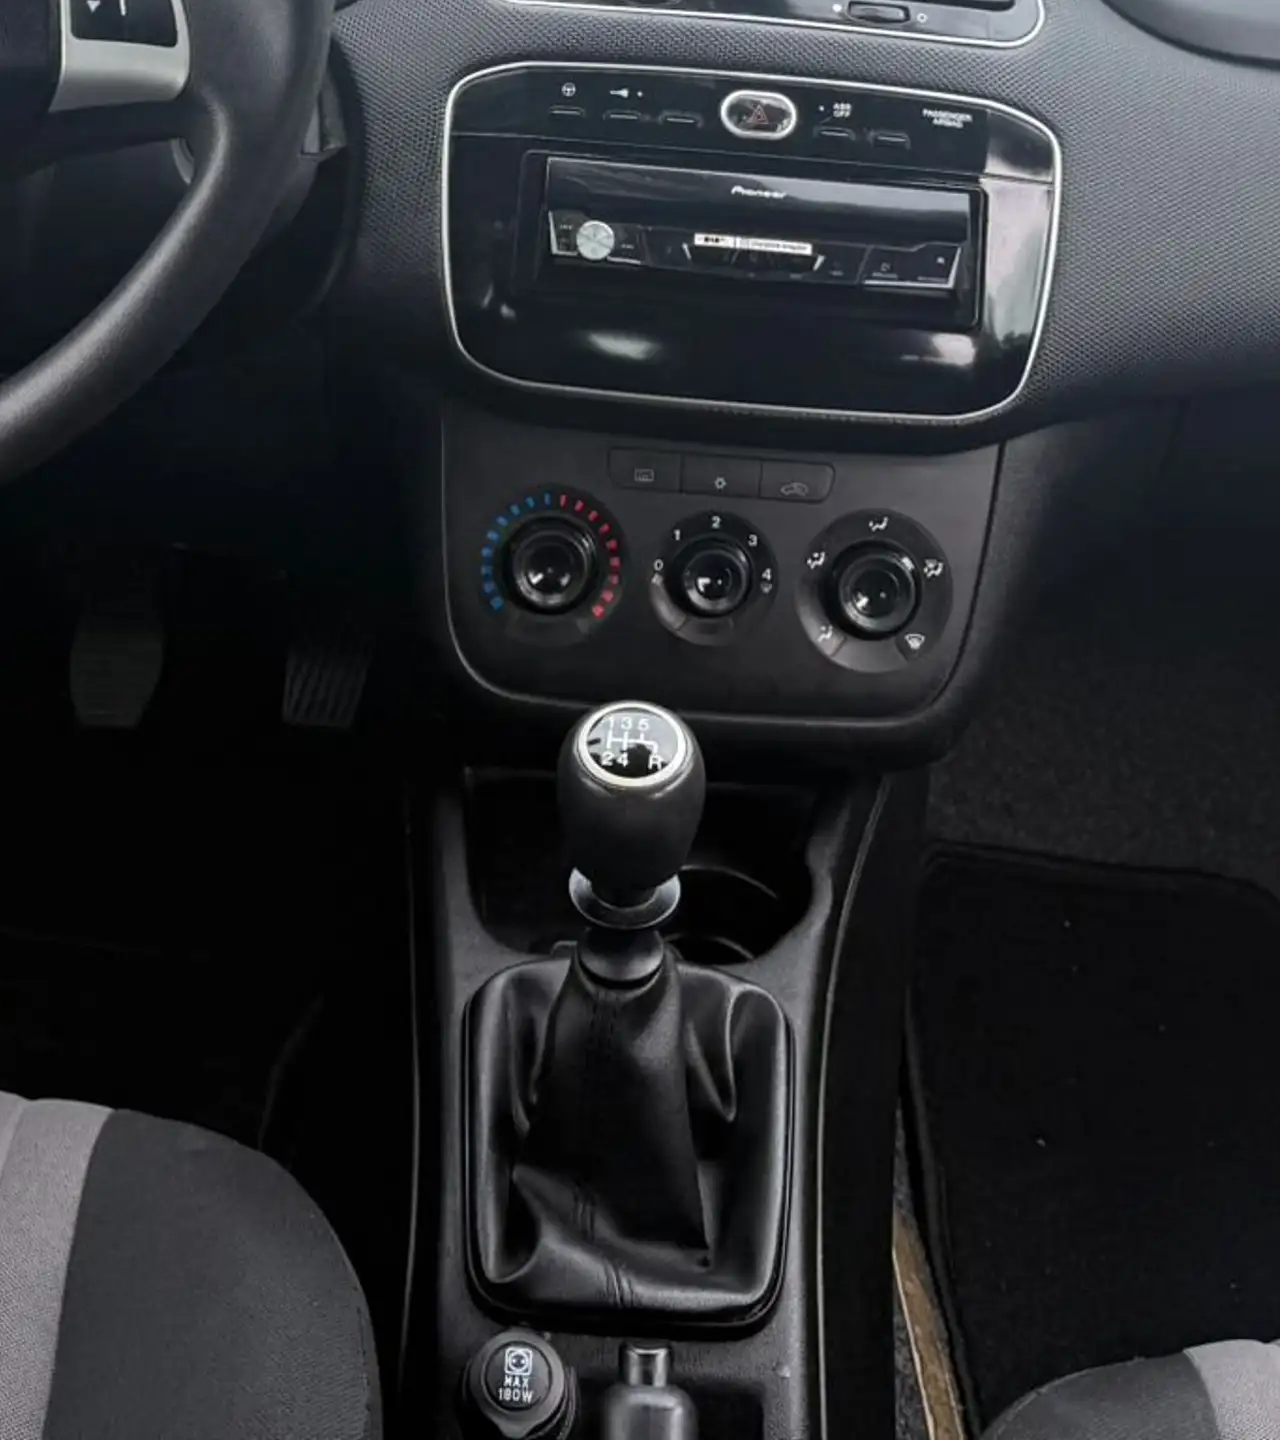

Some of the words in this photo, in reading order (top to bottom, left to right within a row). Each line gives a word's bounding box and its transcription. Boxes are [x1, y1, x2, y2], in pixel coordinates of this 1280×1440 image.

[653, 558, 664, 571] 0
[673, 529, 681, 541] 1
[711, 516, 721, 529] 2
[748, 534, 758, 547] 3
[761, 568, 772, 580] 4
[621, 716, 632, 730] 3
[601, 751, 615, 766] 2
[616, 752, 629, 768] 4
[647, 754, 663, 770] R
[504, 1374, 529, 1388] MAX
[498, 1387, 534, 1404] 180W
